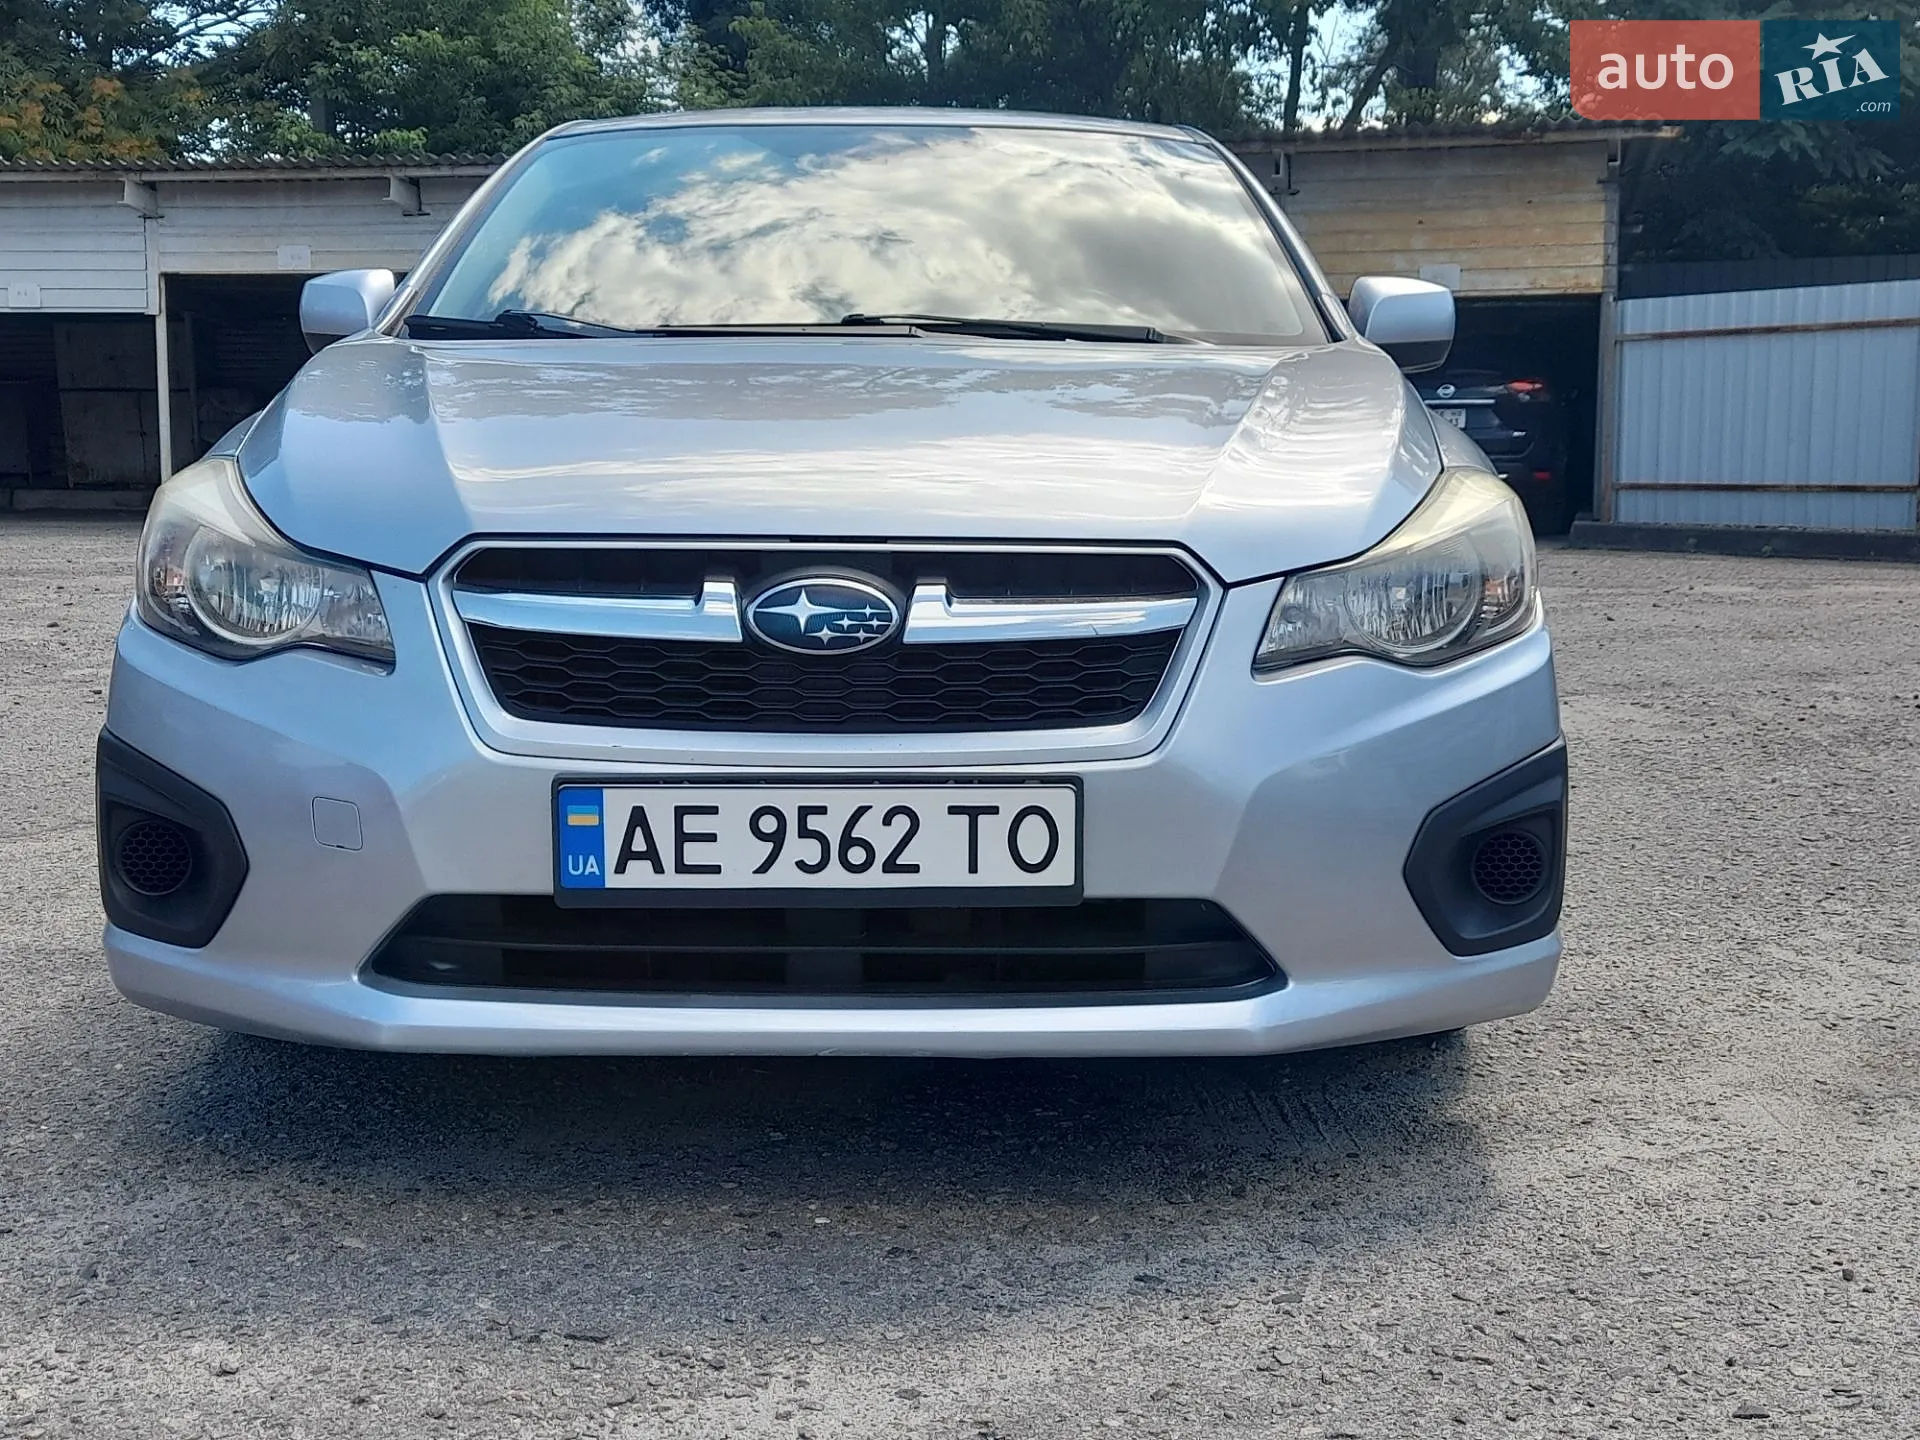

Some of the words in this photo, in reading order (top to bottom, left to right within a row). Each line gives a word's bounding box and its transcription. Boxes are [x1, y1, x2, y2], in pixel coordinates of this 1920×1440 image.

[613, 804, 722, 875] AE
[748, 804, 921, 875] 9562
[946, 804, 1060, 875] TO
[568, 854, 600, 876] UA
